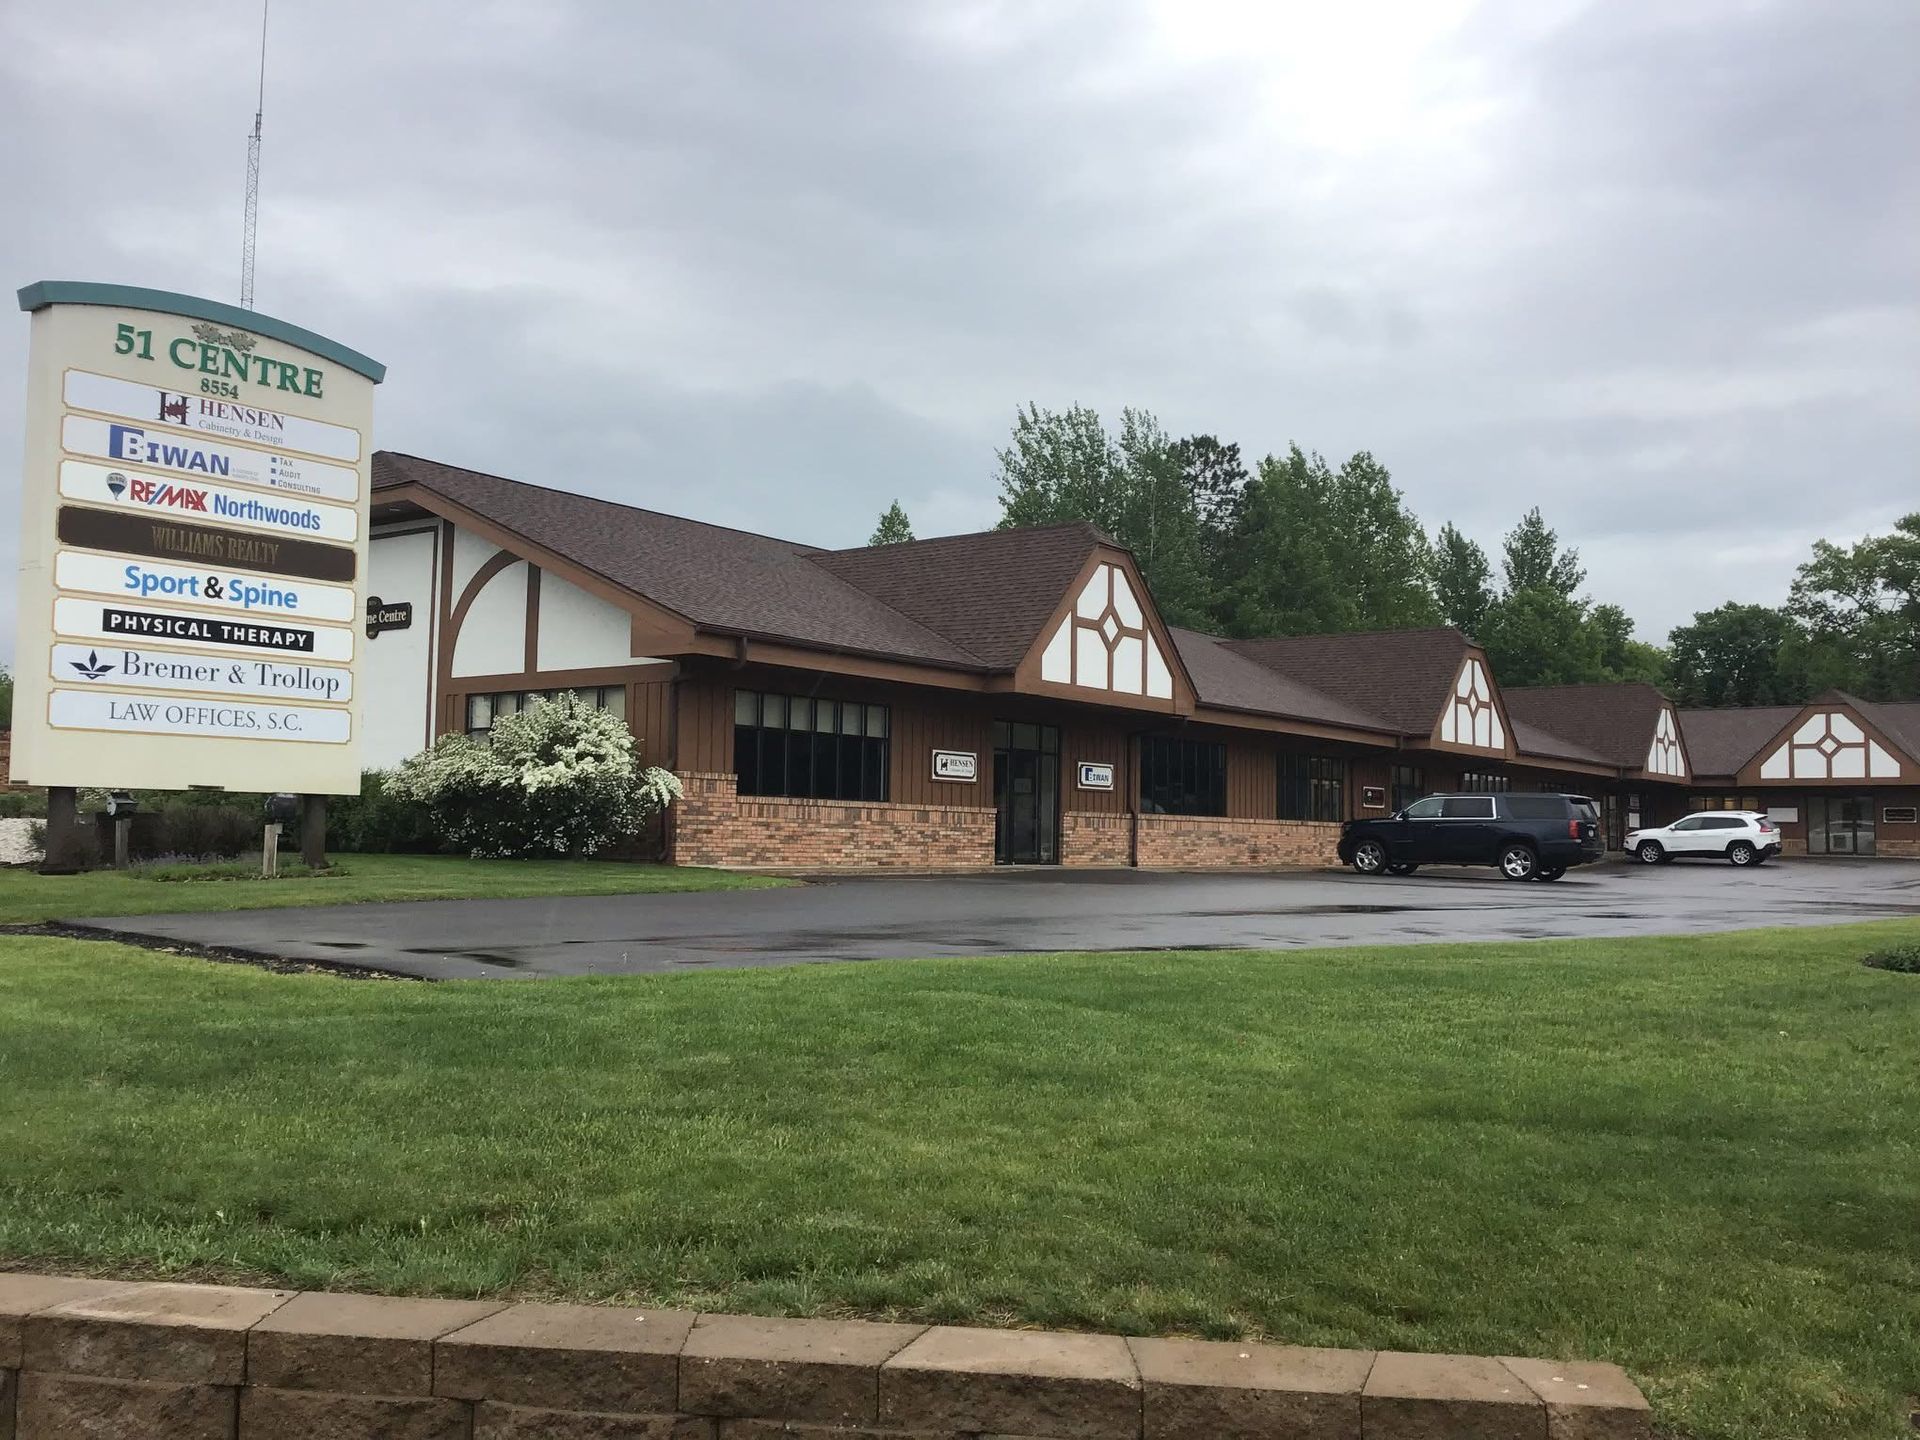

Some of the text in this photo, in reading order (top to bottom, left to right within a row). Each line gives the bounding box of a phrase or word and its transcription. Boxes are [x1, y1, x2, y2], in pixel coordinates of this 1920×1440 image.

[115, 323, 323, 399] 51 CENTRE
[200, 378, 239, 400] 8554
[200, 399, 285, 431] HENSEN
[198, 419, 283, 446] Cabinetry & Design
[279, 469, 302, 480] AUDIT
[280, 457, 294, 467] TAX
[278, 480, 321, 495] CONSULTING
[130, 479, 320, 531] RE/MAX Northwoods
[152, 525, 280, 566] WILLIAMS REALTY
[124, 565, 298, 608] Sport & Spine
[110, 613, 308, 648] PHYSICAL THERAPY
[367, 610, 407, 624] ne Centre
[121, 651, 340, 700] Bremer & Trollop
[109, 701, 303, 732] LAW OFFICES, S.C.
[950, 758, 973, 768] HENSEN
